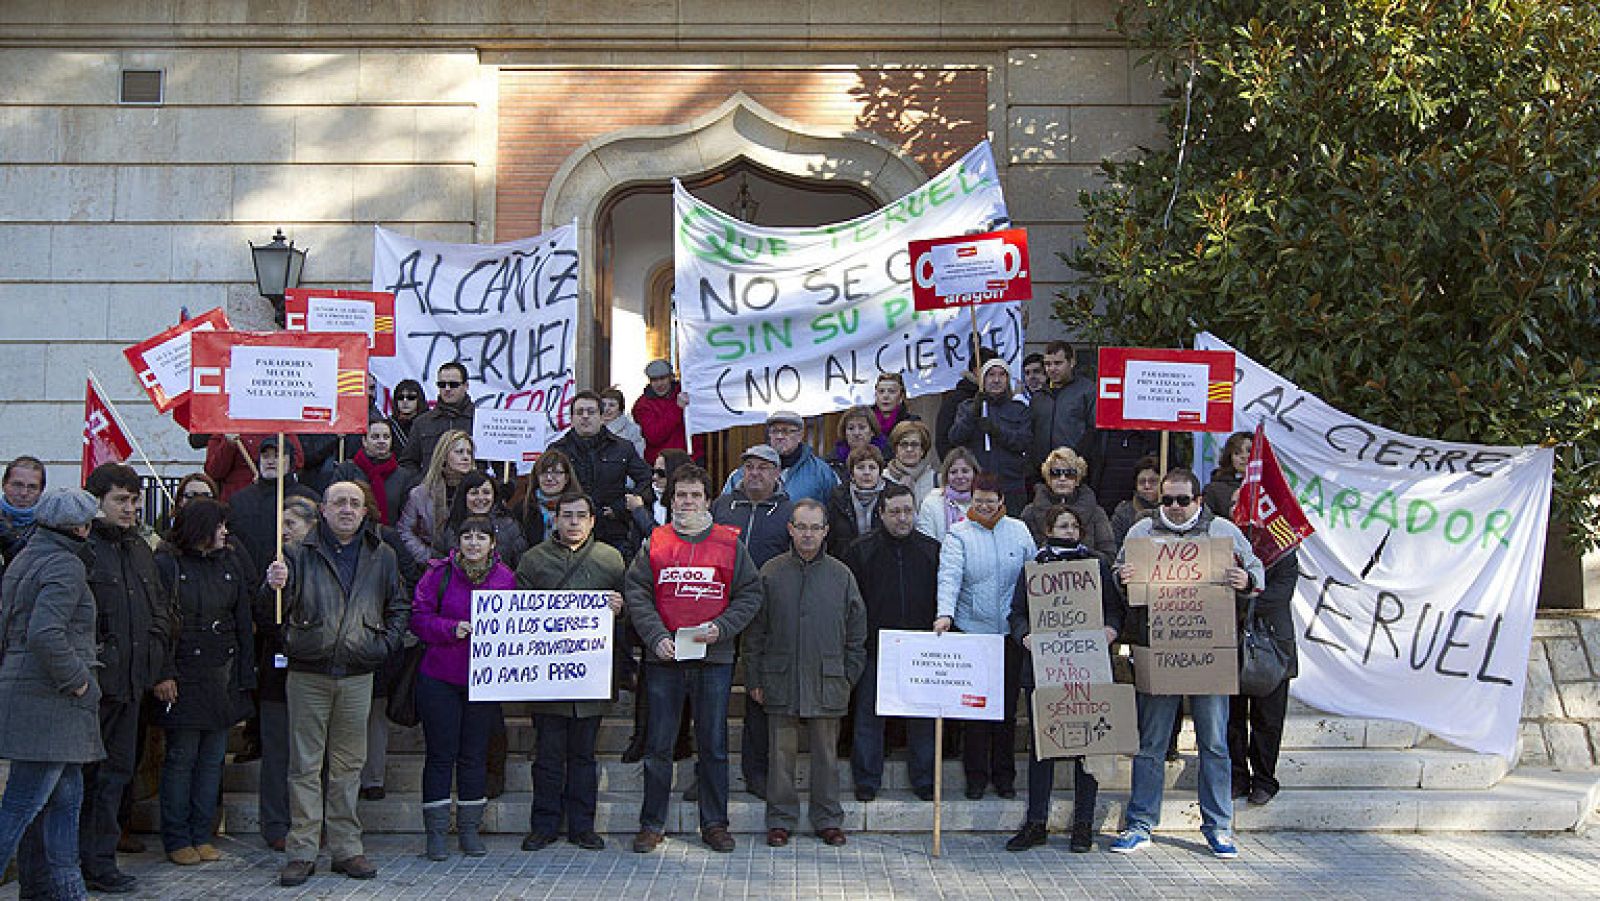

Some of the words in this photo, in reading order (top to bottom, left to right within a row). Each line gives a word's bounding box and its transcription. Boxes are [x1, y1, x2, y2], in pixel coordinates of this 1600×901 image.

[800, 164, 992, 248] TERUEL
[385, 241, 577, 315] ALCAÑIZ
[699, 273, 779, 322] NO
[803, 264, 870, 305] SE
[706, 319, 792, 360] SIN
[810, 308, 860, 345] SU
[255, 358, 313, 368] PARADORES
[825, 351, 867, 392] AL
[266, 368, 301, 377] MUCHA
[1243, 385, 1305, 433] AL
[1325, 424, 1513, 478] CIERRE
[1157, 542, 1199, 561] NO
[1151, 565, 1162, 582] A
[1166, 563, 1202, 581] LOS
[1029, 570, 1096, 597] CONTRA
[1158, 585, 1197, 600] SUPER
[476, 594, 502, 615] NO
[547, 593, 609, 610] DESPIDOS
[1052, 595, 1073, 608] EL
[1152, 600, 1203, 612] SUELDOS
[475, 618, 499, 636] NO
[506, 617, 515, 634] A
[518, 617, 540, 634] LOS
[1037, 610, 1087, 629] ABUSO
[1152, 615, 1164, 627] A
[1168, 614, 1207, 626] COSTA
[1168, 629, 1214, 641] NUESTRO
[472, 642, 492, 659] NO
[1040, 639, 1098, 655] PODER
[1060, 657, 1073, 666] EL
[1154, 652, 1215, 668] TRABAJO
[472, 667, 492, 686] NO
[547, 663, 586, 680] PARO
[1045, 667, 1090, 682] PARO
[1047, 702, 1111, 718] SENTIDO
